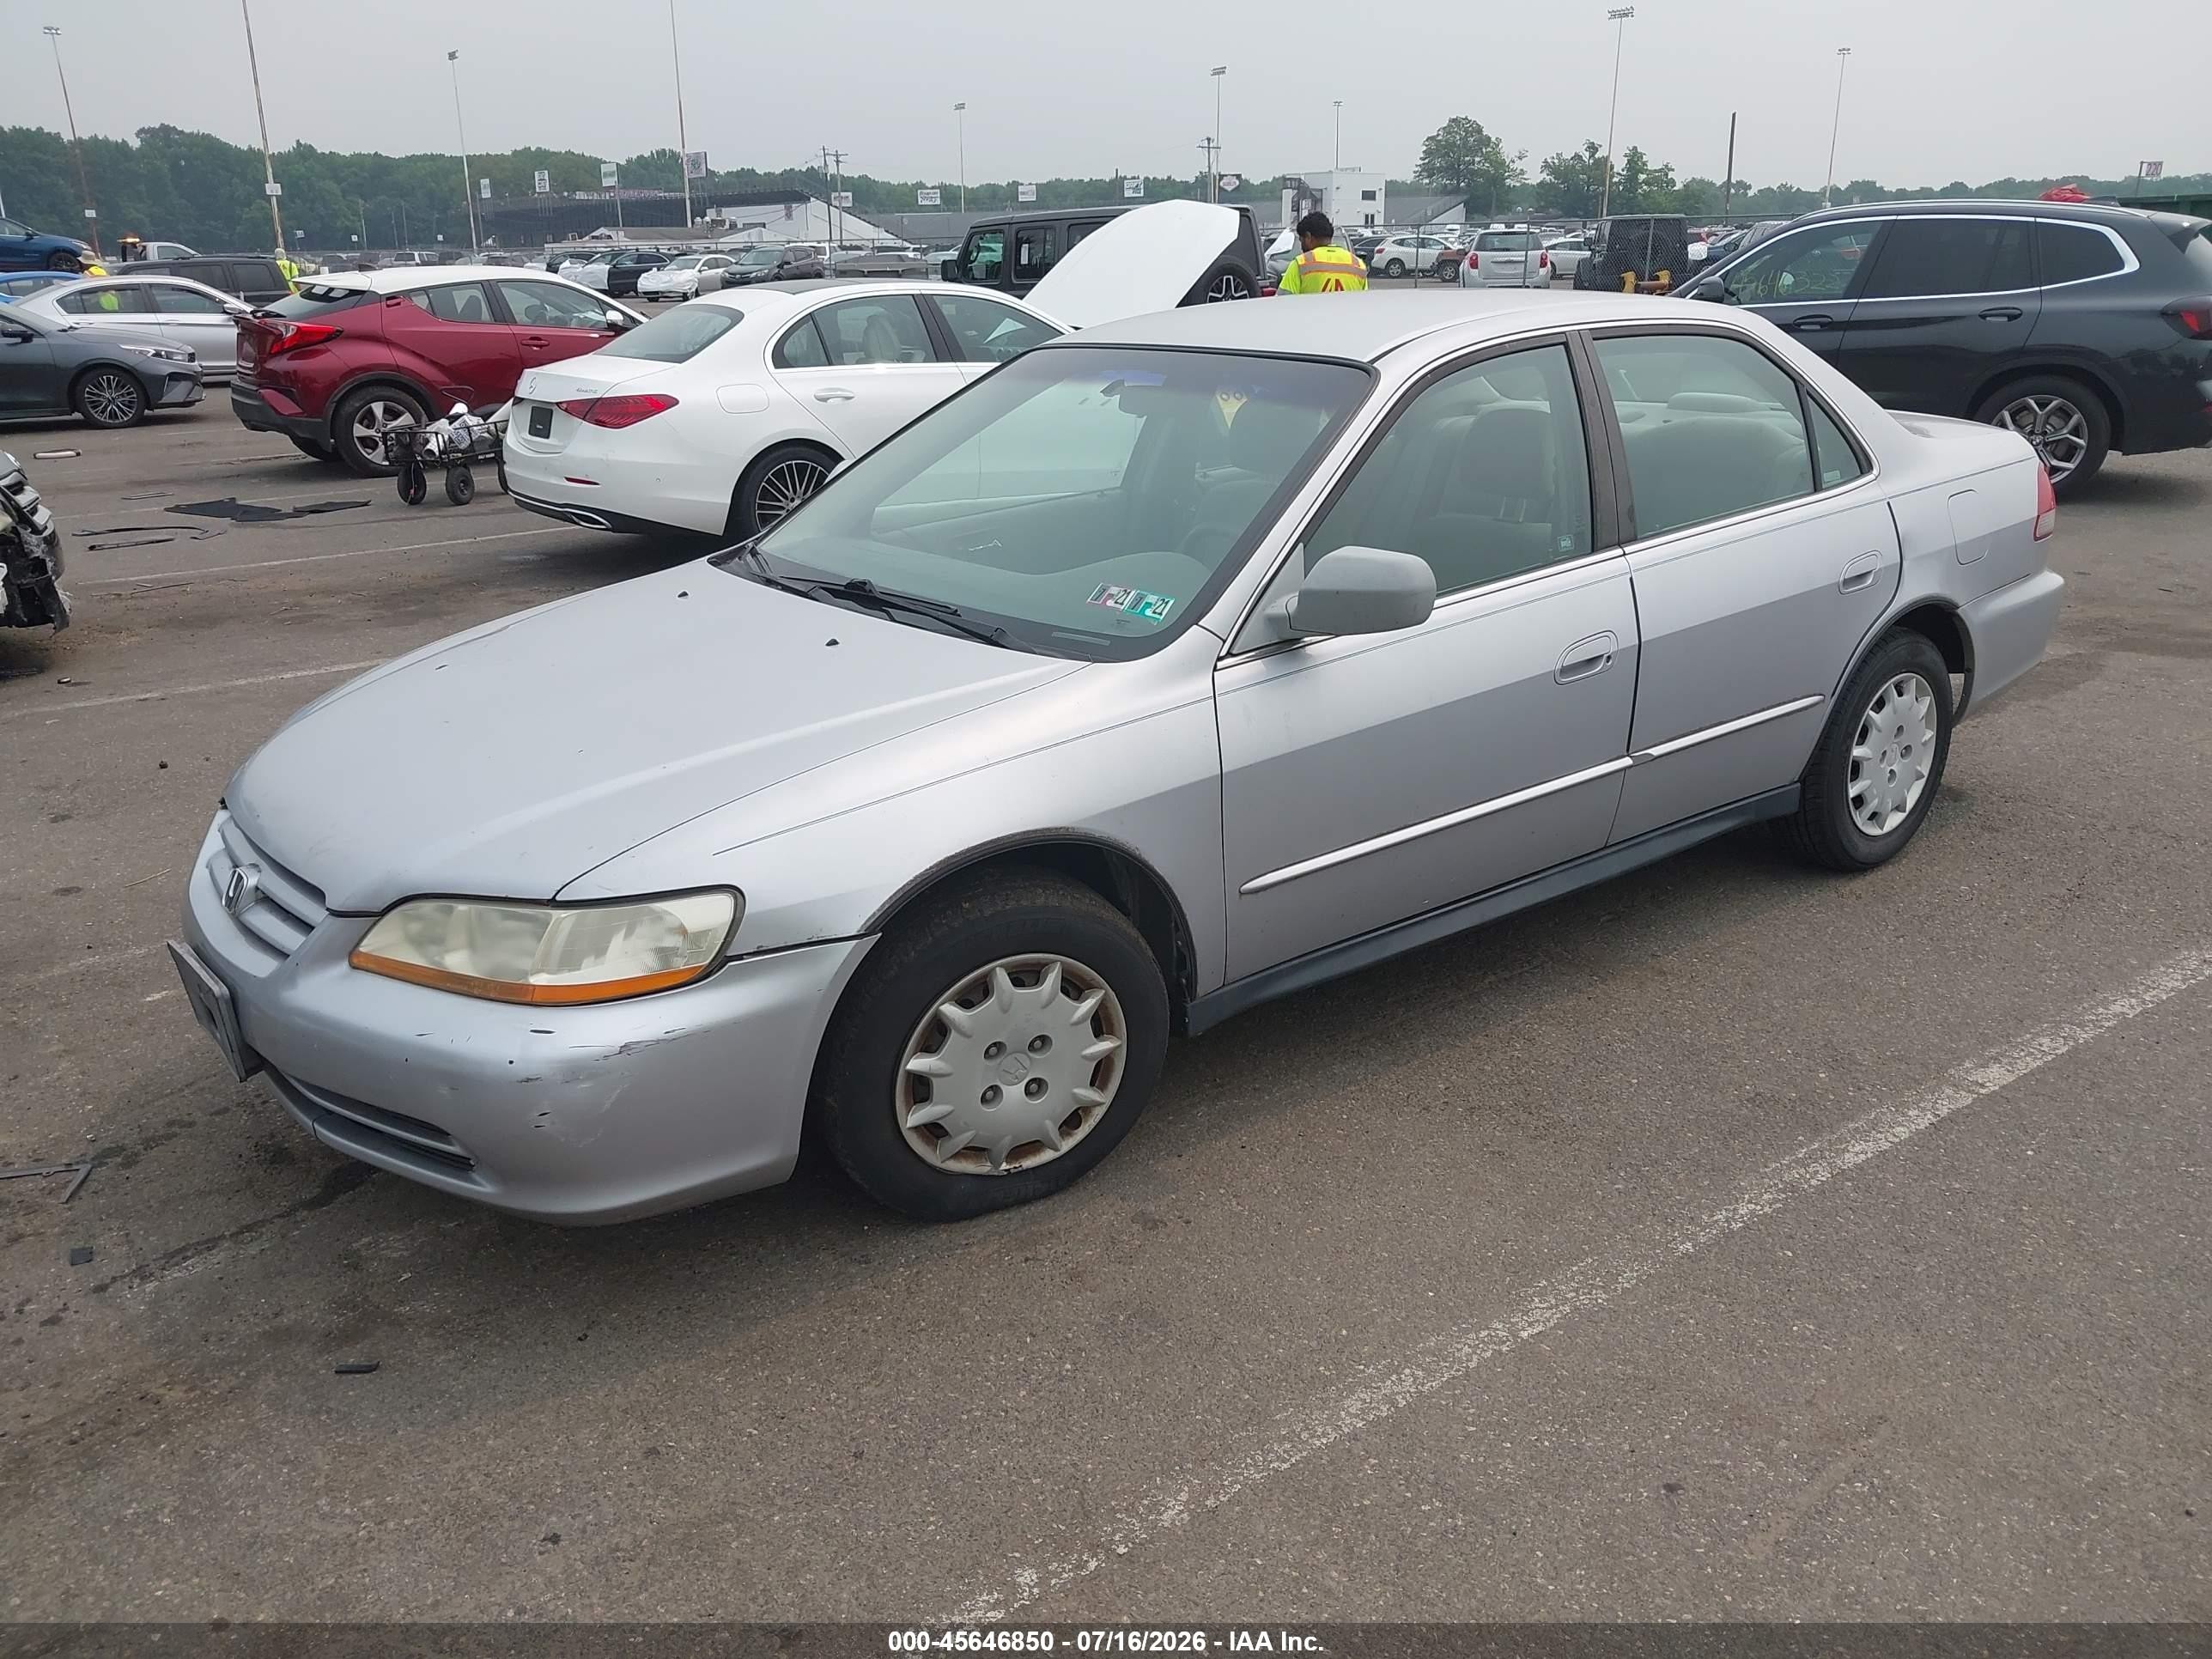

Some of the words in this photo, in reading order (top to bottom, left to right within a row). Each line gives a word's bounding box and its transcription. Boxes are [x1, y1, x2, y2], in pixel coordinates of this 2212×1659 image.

[2146, 163, 2162, 176] 220
[1115, 589, 1131, 605] 21
[1152, 599, 1170, 616] 21
